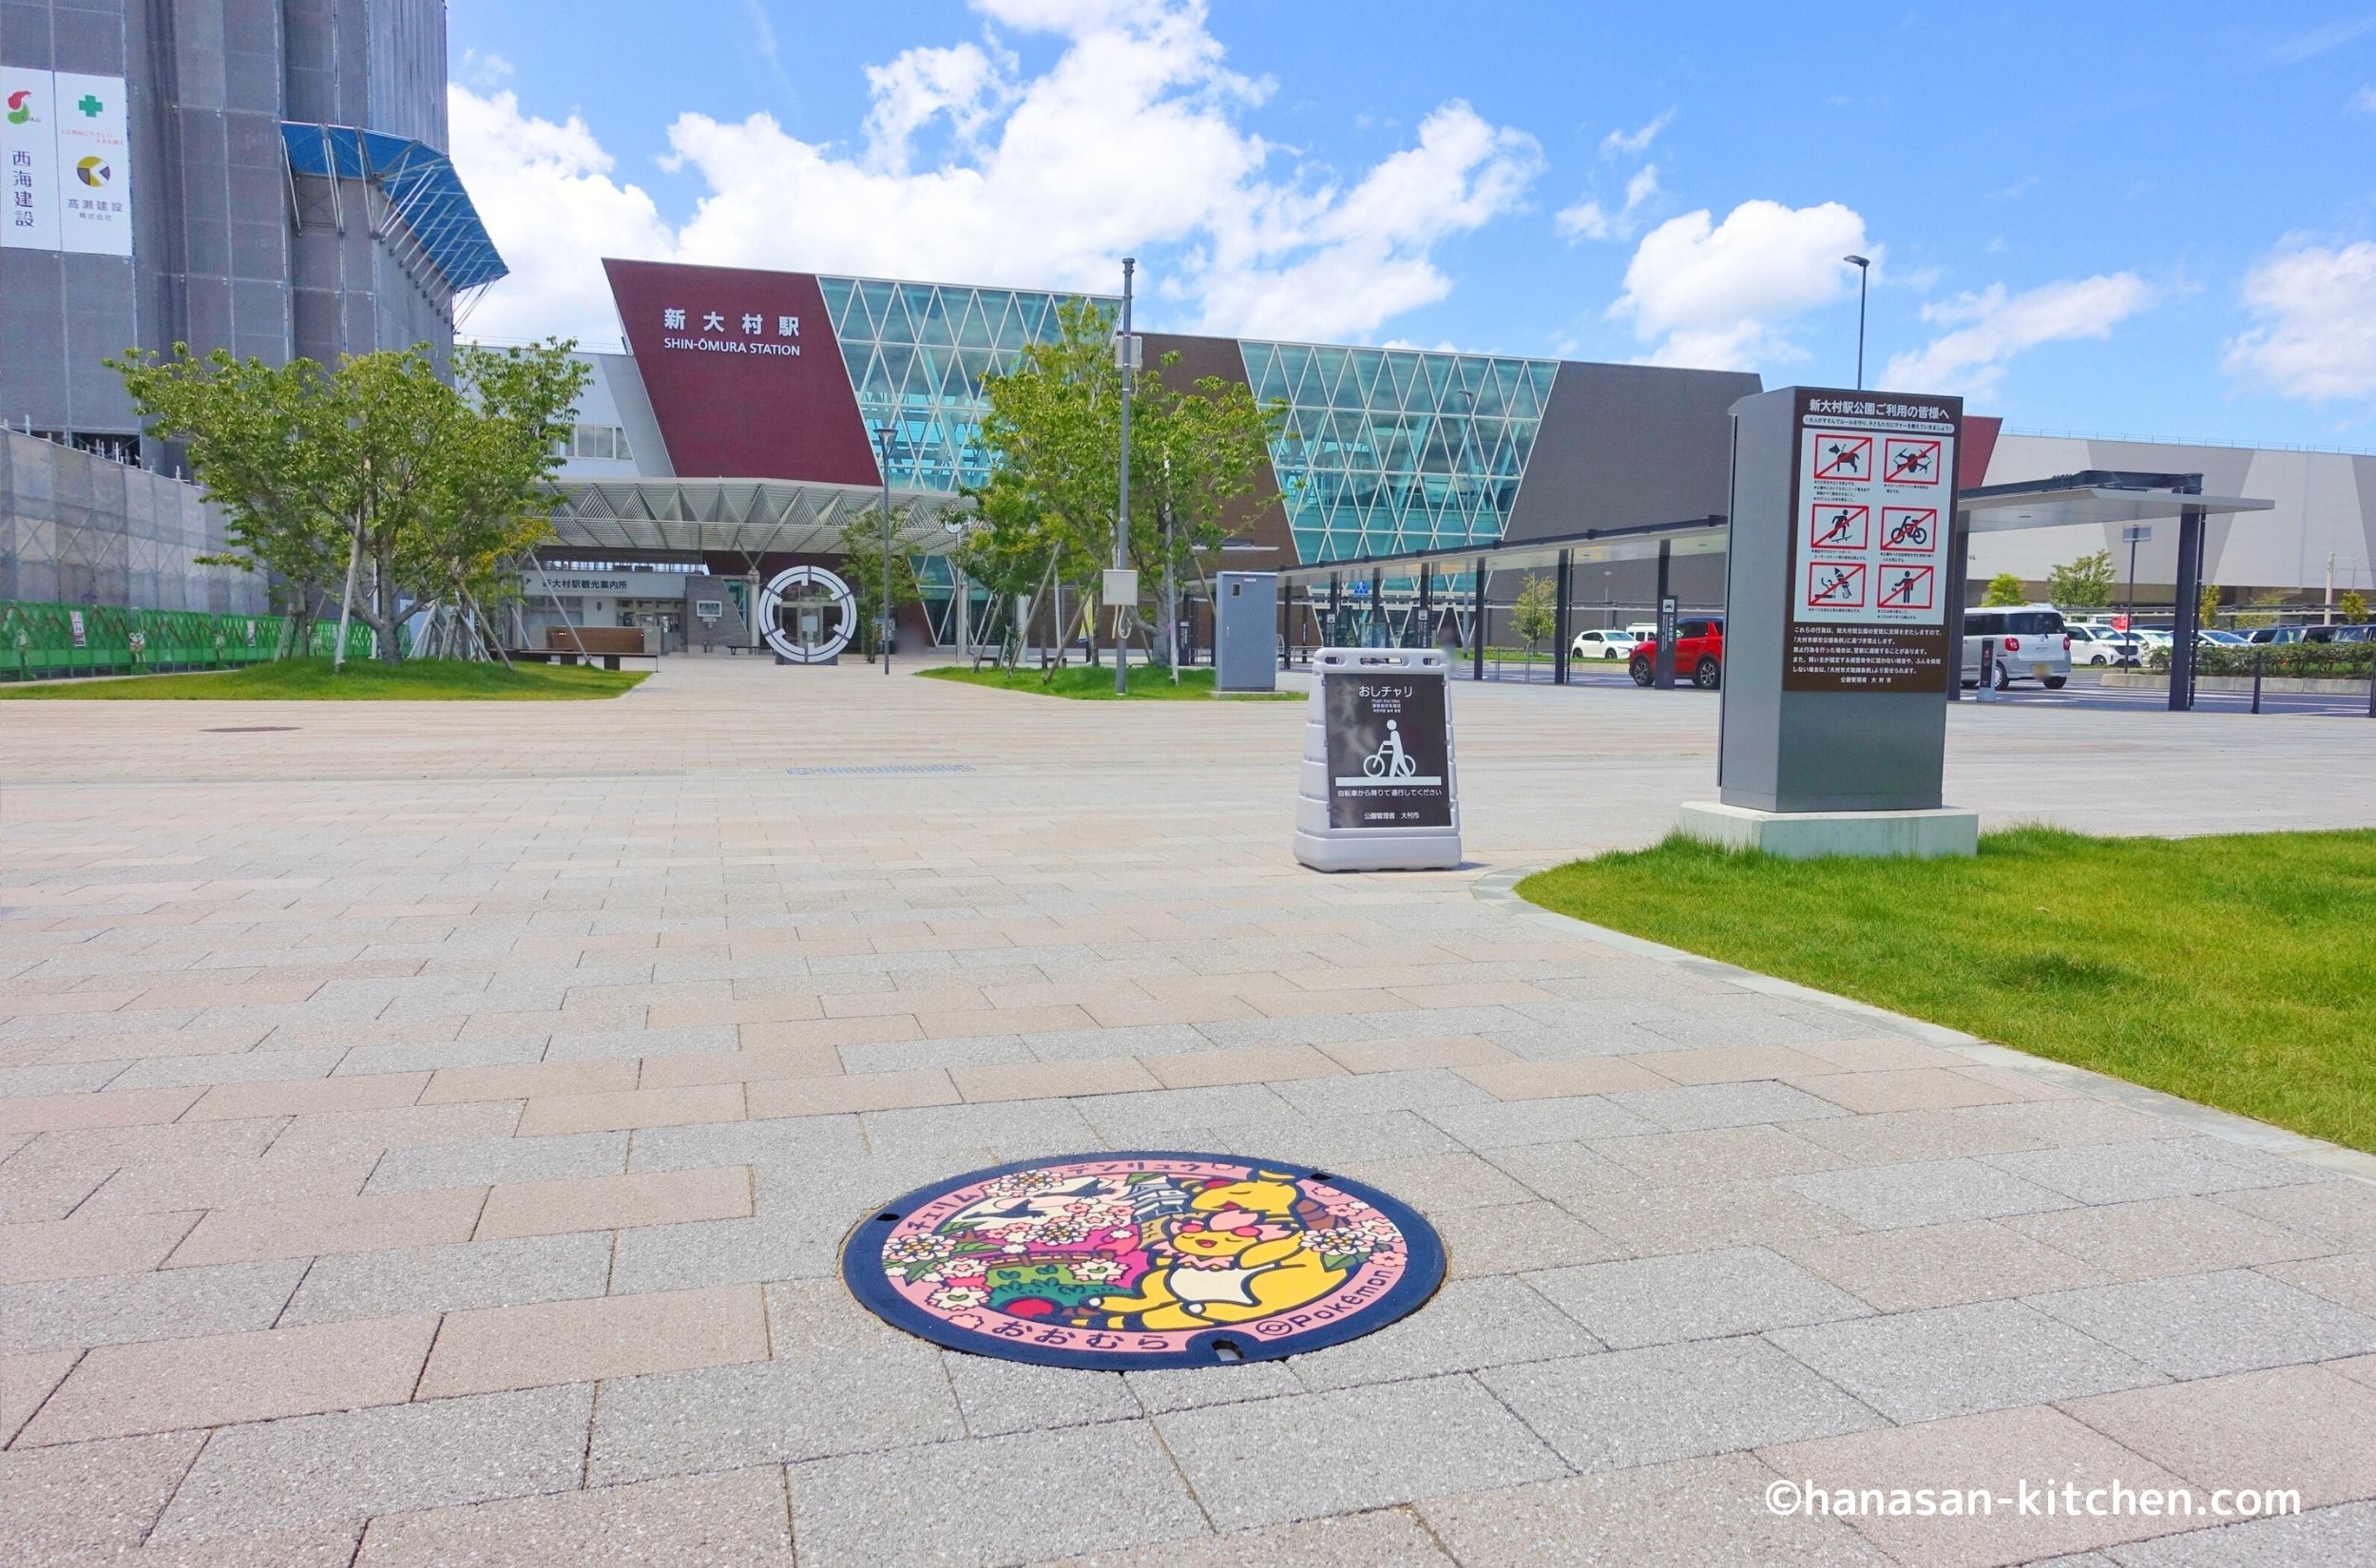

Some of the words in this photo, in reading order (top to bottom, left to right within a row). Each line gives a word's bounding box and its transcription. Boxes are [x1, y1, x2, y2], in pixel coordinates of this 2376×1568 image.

[12, 150, 35, 227] 西海建設
[79, 212, 112, 221] 株式会社
[664, 308, 800, 336] 新大村駅
[750, 343, 800, 355] STATION
[1809, 398, 1950, 420] 新大村駅公園ご利用の皆様へ
[1358, 685, 1413, 698] おしチャリ
[1337, 789, 1442, 797] 自転車から降りて通行してください
[1066, 1161, 1201, 1174] デンリュウ
[907, 1193, 981, 1232] チェリム
[991, 1320, 1170, 1350] おおむら
